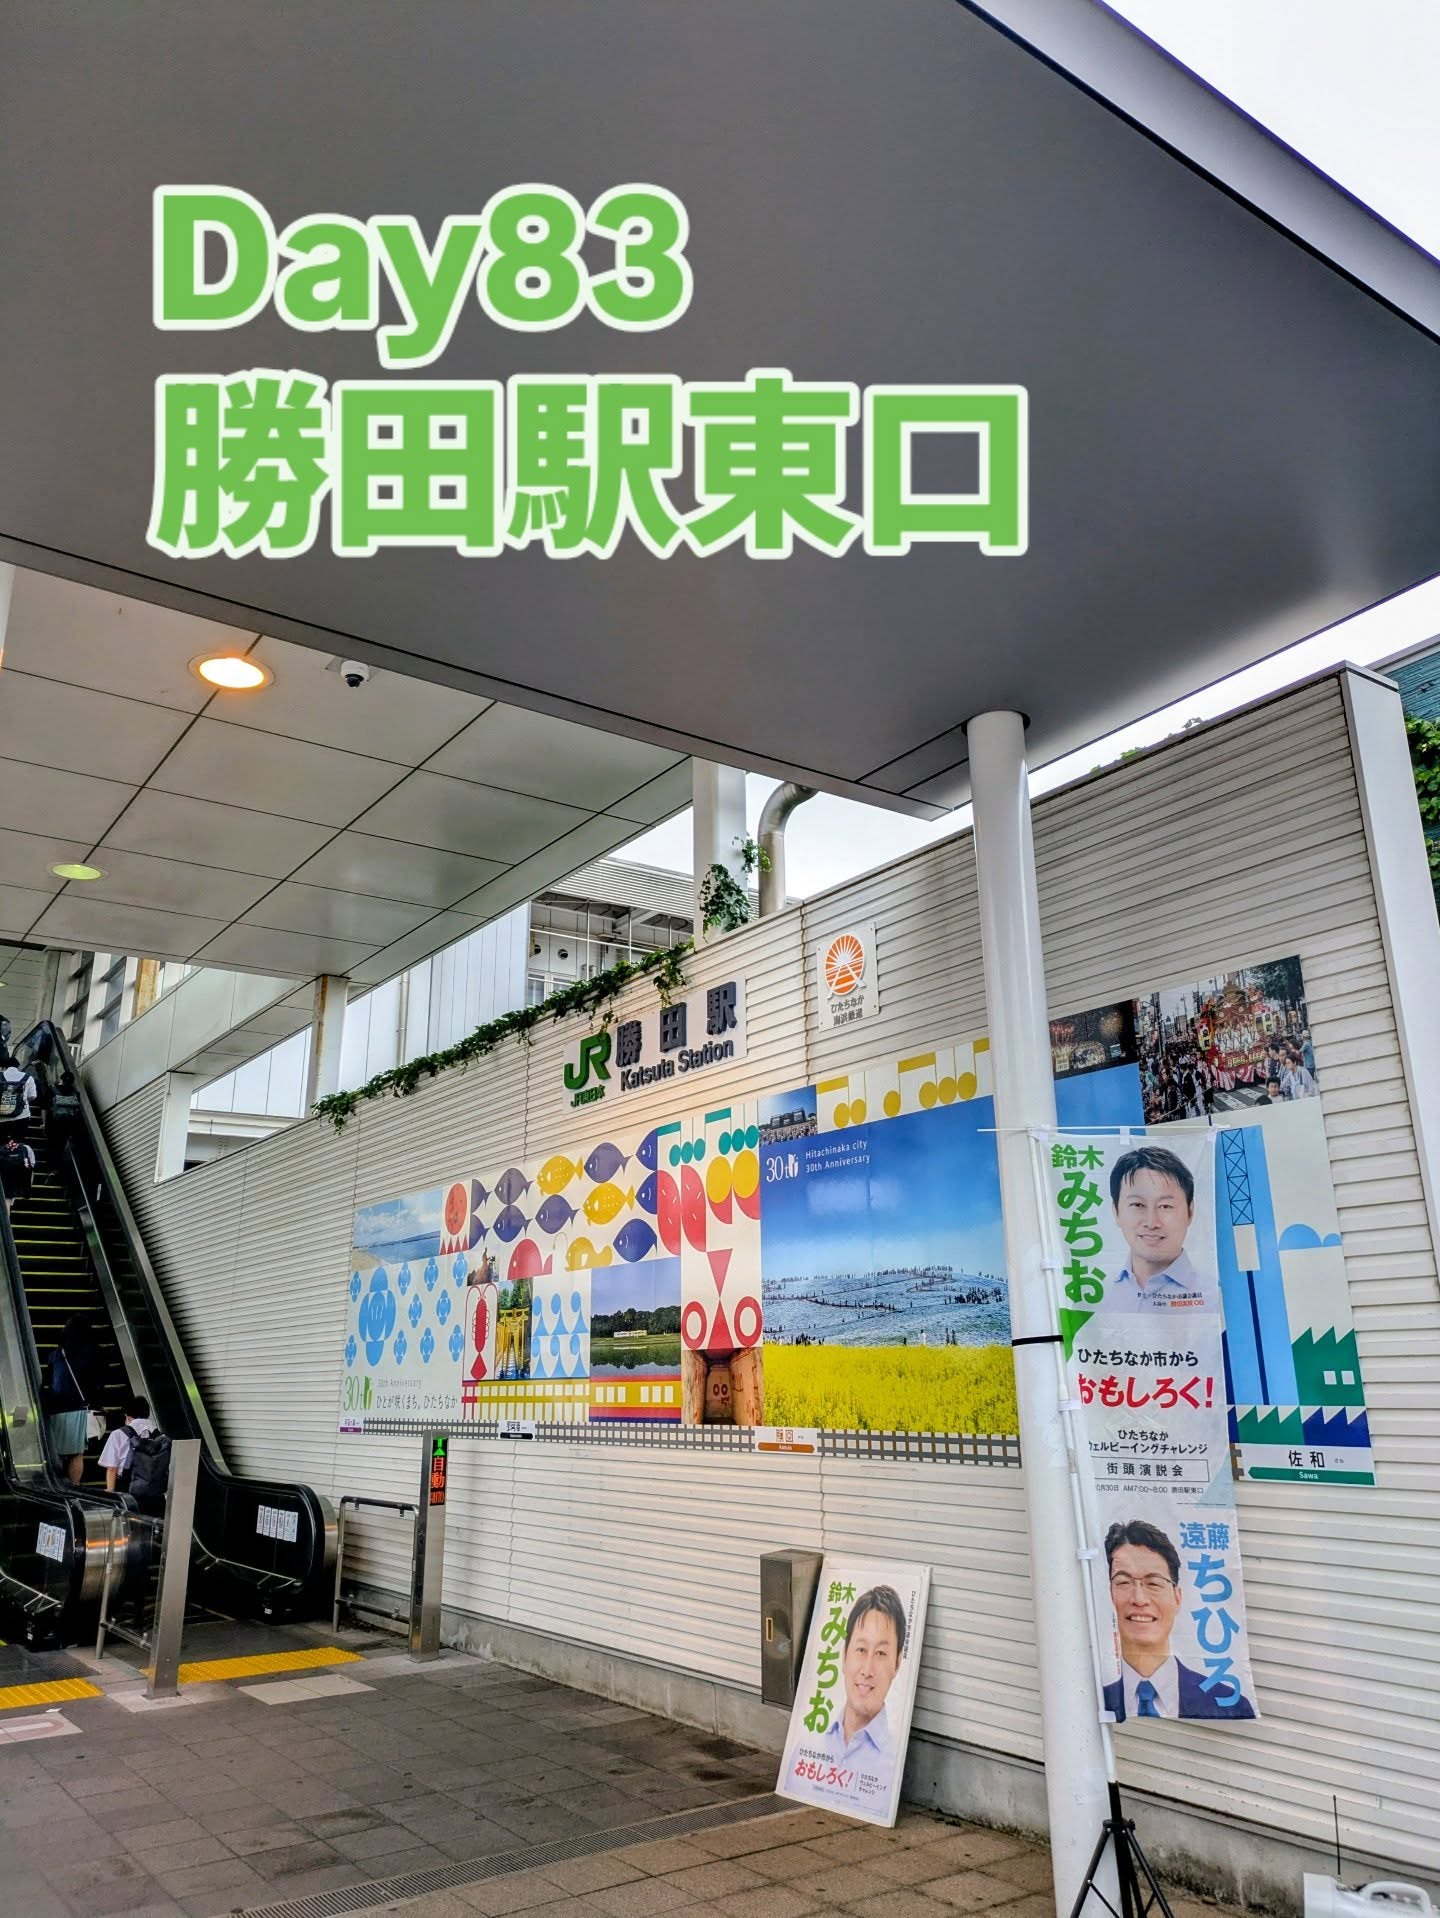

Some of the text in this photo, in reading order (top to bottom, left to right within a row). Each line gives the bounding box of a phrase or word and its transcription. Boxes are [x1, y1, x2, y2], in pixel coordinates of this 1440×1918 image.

[831, 995, 864, 1013] ひたちなか
[615, 981, 737, 1068] 勝田駅
[564, 1032, 611, 1090] JR
[620, 1039, 734, 1092] Katsuta Station
[805, 1139, 868, 1160] Hitachinaka city
[1051, 1143, 1104, 1170] 鈴木
[806, 1154, 870, 1173] 30th Anniversary
[1057, 1171, 1106, 1304] みちお
[1078, 1348, 1199, 1368] ひたちなか市から
[390, 1378, 422, 1389] Anniversary
[1078, 1372, 1214, 1410] おもしろく!
[1117, 1429, 1169, 1441] ひたちなか
[431, 1455, 445, 1488] 自動
[1107, 1462, 1183, 1477] 街頭演説会
[1288, 1450, 1326, 1468] 佐和
[1299, 1471, 1319, 1480] Sawa
[1179, 1521, 1230, 1551] 遠藤
[827, 1581, 857, 1604] 鈴木
[1187, 1553, 1241, 1707] ちひろ
[803, 1606, 848, 1735] みちお
[799, 1748, 835, 1763] ひたちなか市から
[794, 1759, 854, 1788] おもしろく!
